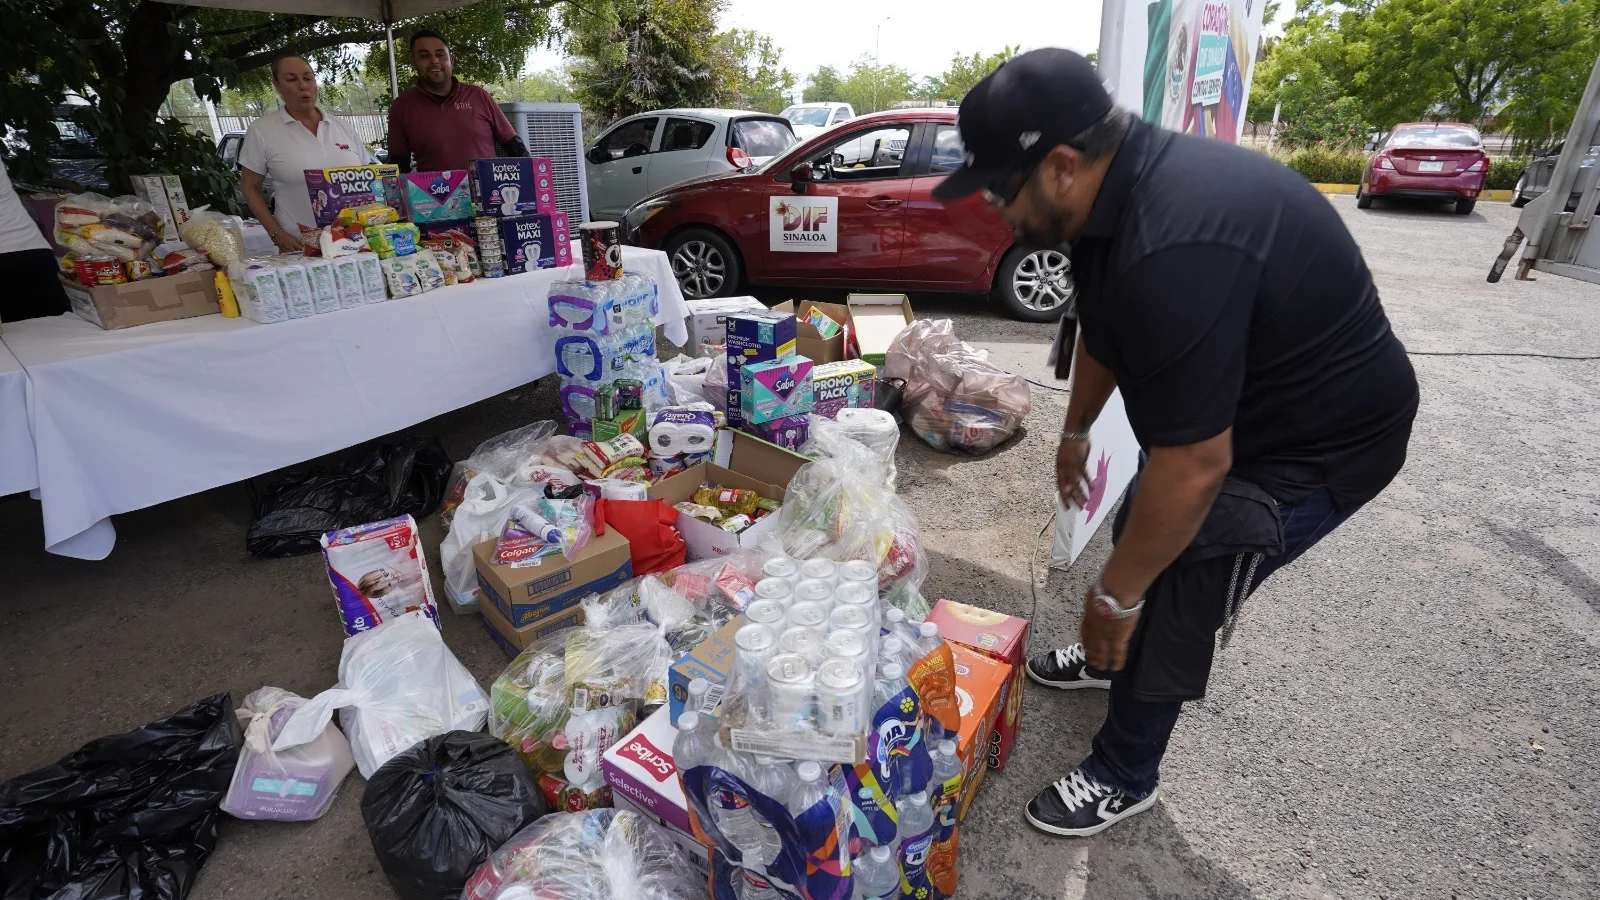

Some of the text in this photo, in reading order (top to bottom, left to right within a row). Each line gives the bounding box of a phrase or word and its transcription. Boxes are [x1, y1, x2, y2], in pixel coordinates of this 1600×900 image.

[492, 162, 519, 172] kotex
[330, 170, 374, 183] PROMO
[494, 173, 520, 181] MAXI
[341, 181, 371, 193] PACK
[430, 183, 450, 194] Saba
[783, 204, 828, 231] DIF
[516, 221, 540, 231] kotex
[518, 229, 541, 240] MAXI
[783, 233, 827, 241] SINALOA
[728, 334, 750, 342] PREMIUM
[728, 339, 762, 348] WASHCLOTHS
[775, 377, 795, 391] Saba
[814, 375, 853, 391] PROMO
[821, 387, 847, 400] PACK
[500, 546, 538, 558] Colgate
[629, 741, 673, 774] Scribe
[609, 772, 655, 807] Selective
